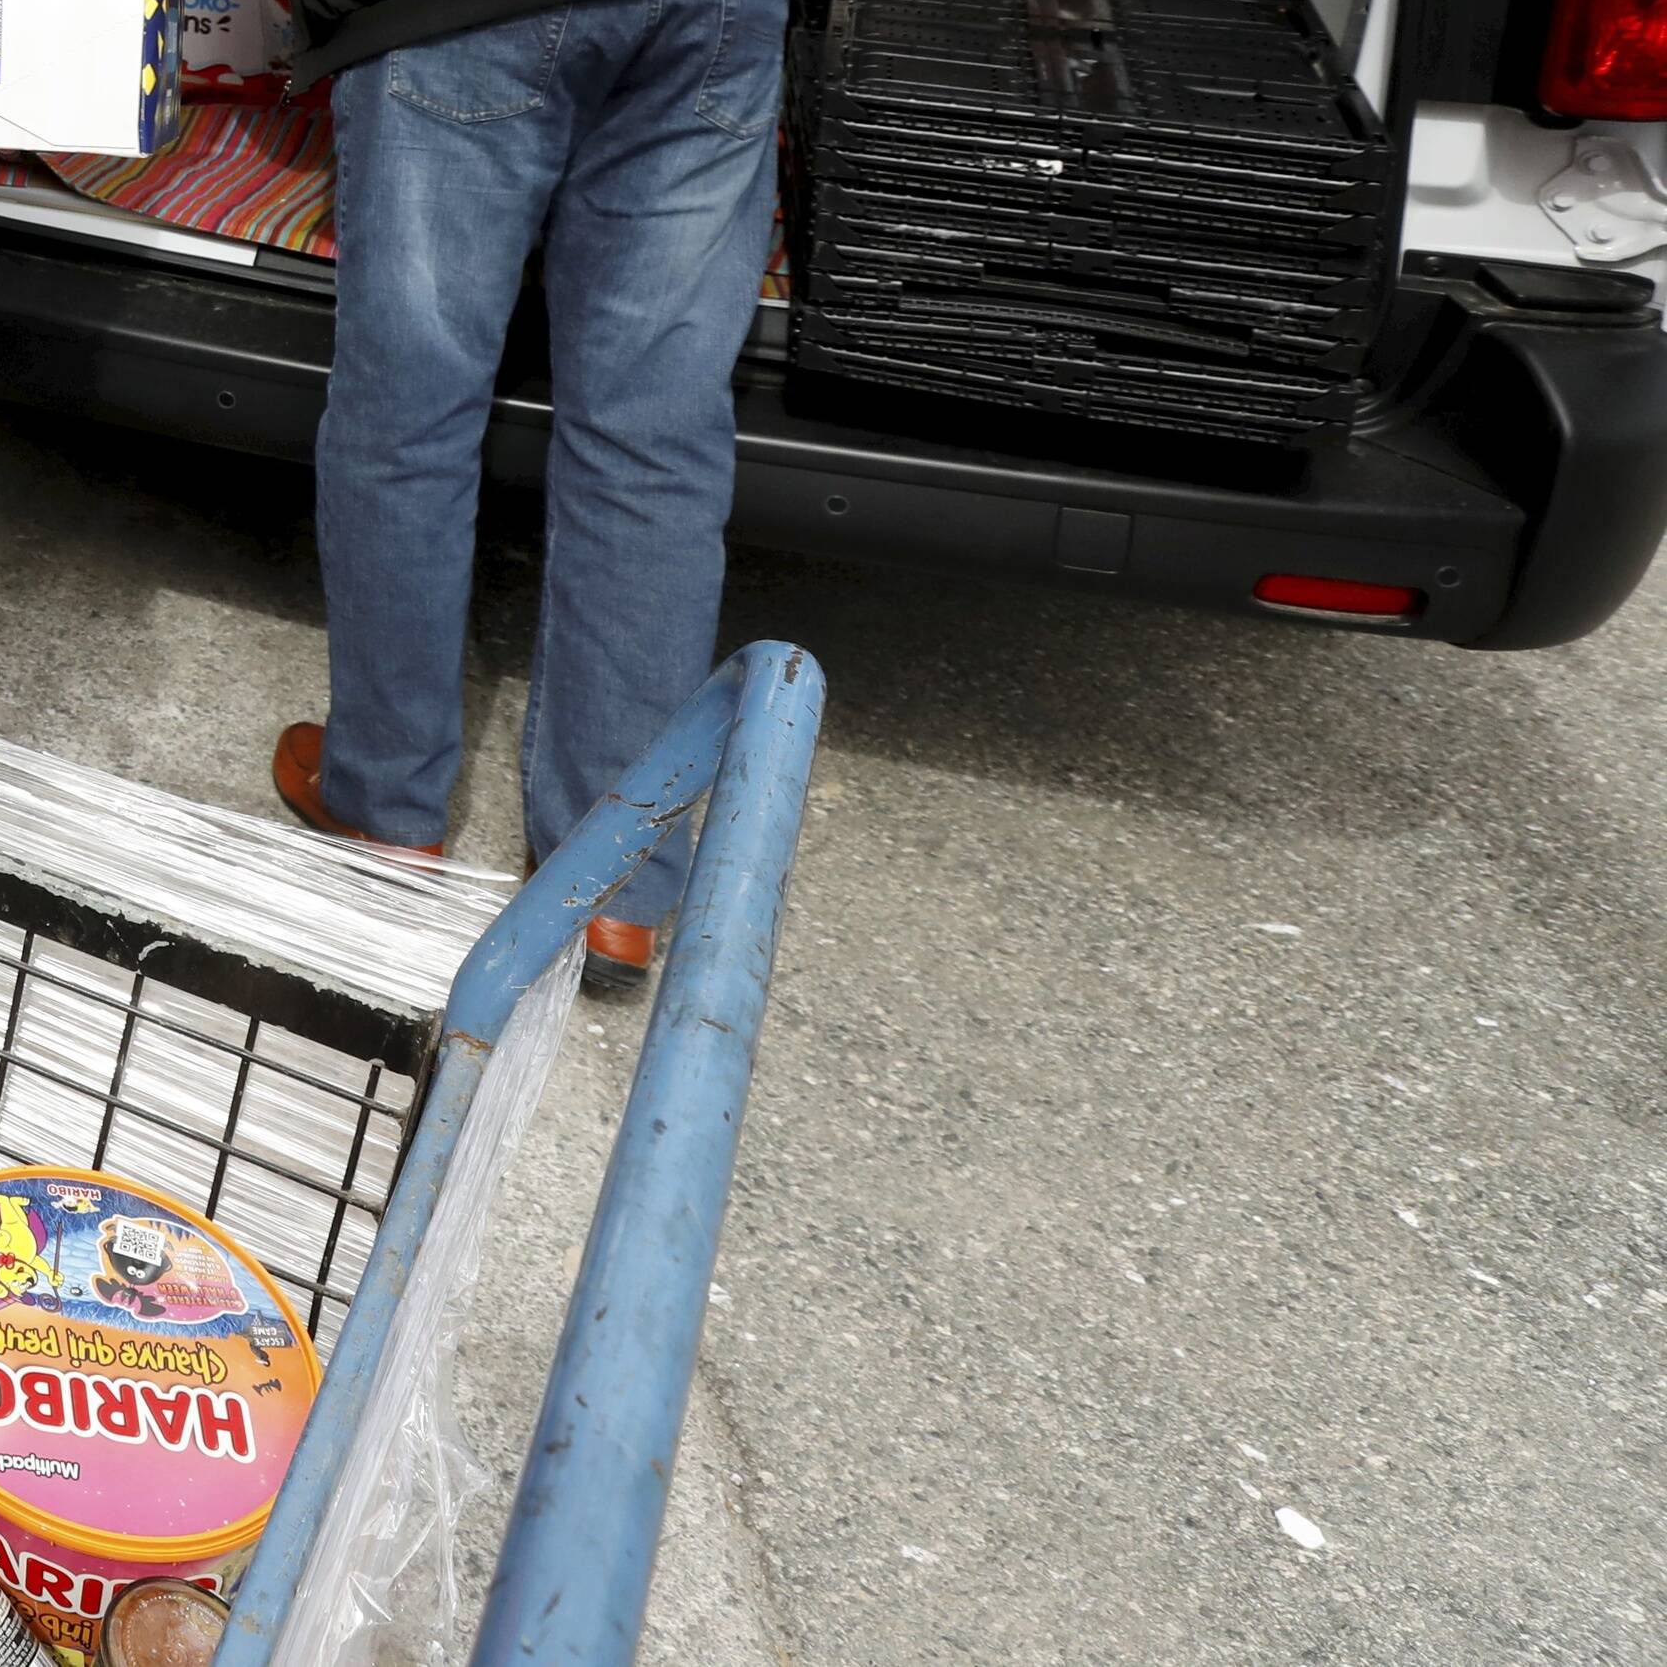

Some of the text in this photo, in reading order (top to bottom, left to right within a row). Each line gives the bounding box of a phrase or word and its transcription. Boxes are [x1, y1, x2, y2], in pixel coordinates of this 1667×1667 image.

[47, 1183, 102, 1202] HARIBO
[66, 1328, 115, 1369] qui
[119, 1339, 229, 1387] Chauve
